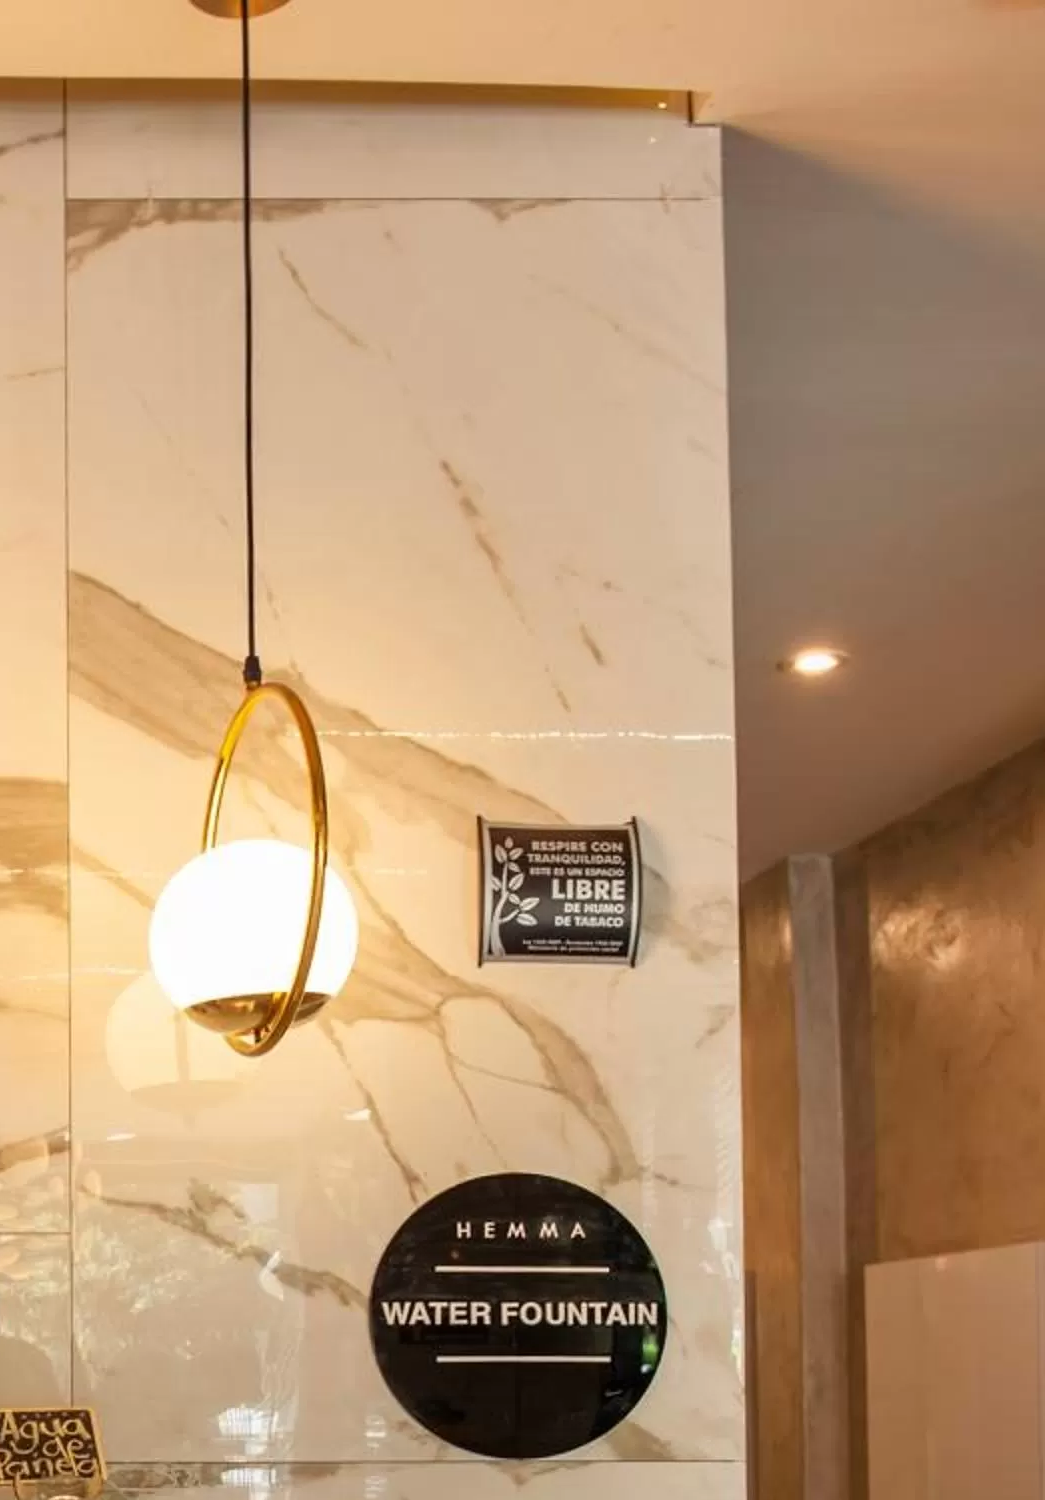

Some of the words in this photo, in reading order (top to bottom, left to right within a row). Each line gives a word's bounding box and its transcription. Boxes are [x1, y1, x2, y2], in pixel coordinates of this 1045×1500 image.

[531, 841, 587, 852] RESPIRE
[590, 842, 623, 852] CON
[584, 868, 625, 876] ESPACIO
[551, 879, 626, 900] LIBRE
[564, 903, 581, 913] DE
[584, 903, 625, 914] HUMO
[555, 915, 572, 926] DE
[574, 916, 624, 927] TABACO
[456, 1222, 586, 1239] HEMMA
[382, 1301, 492, 1325] WATER
[500, 1302, 658, 1326] FOUNTAIN
[0, 1411, 92, 1455] Agua
[42, 1437, 91, 1461] de
